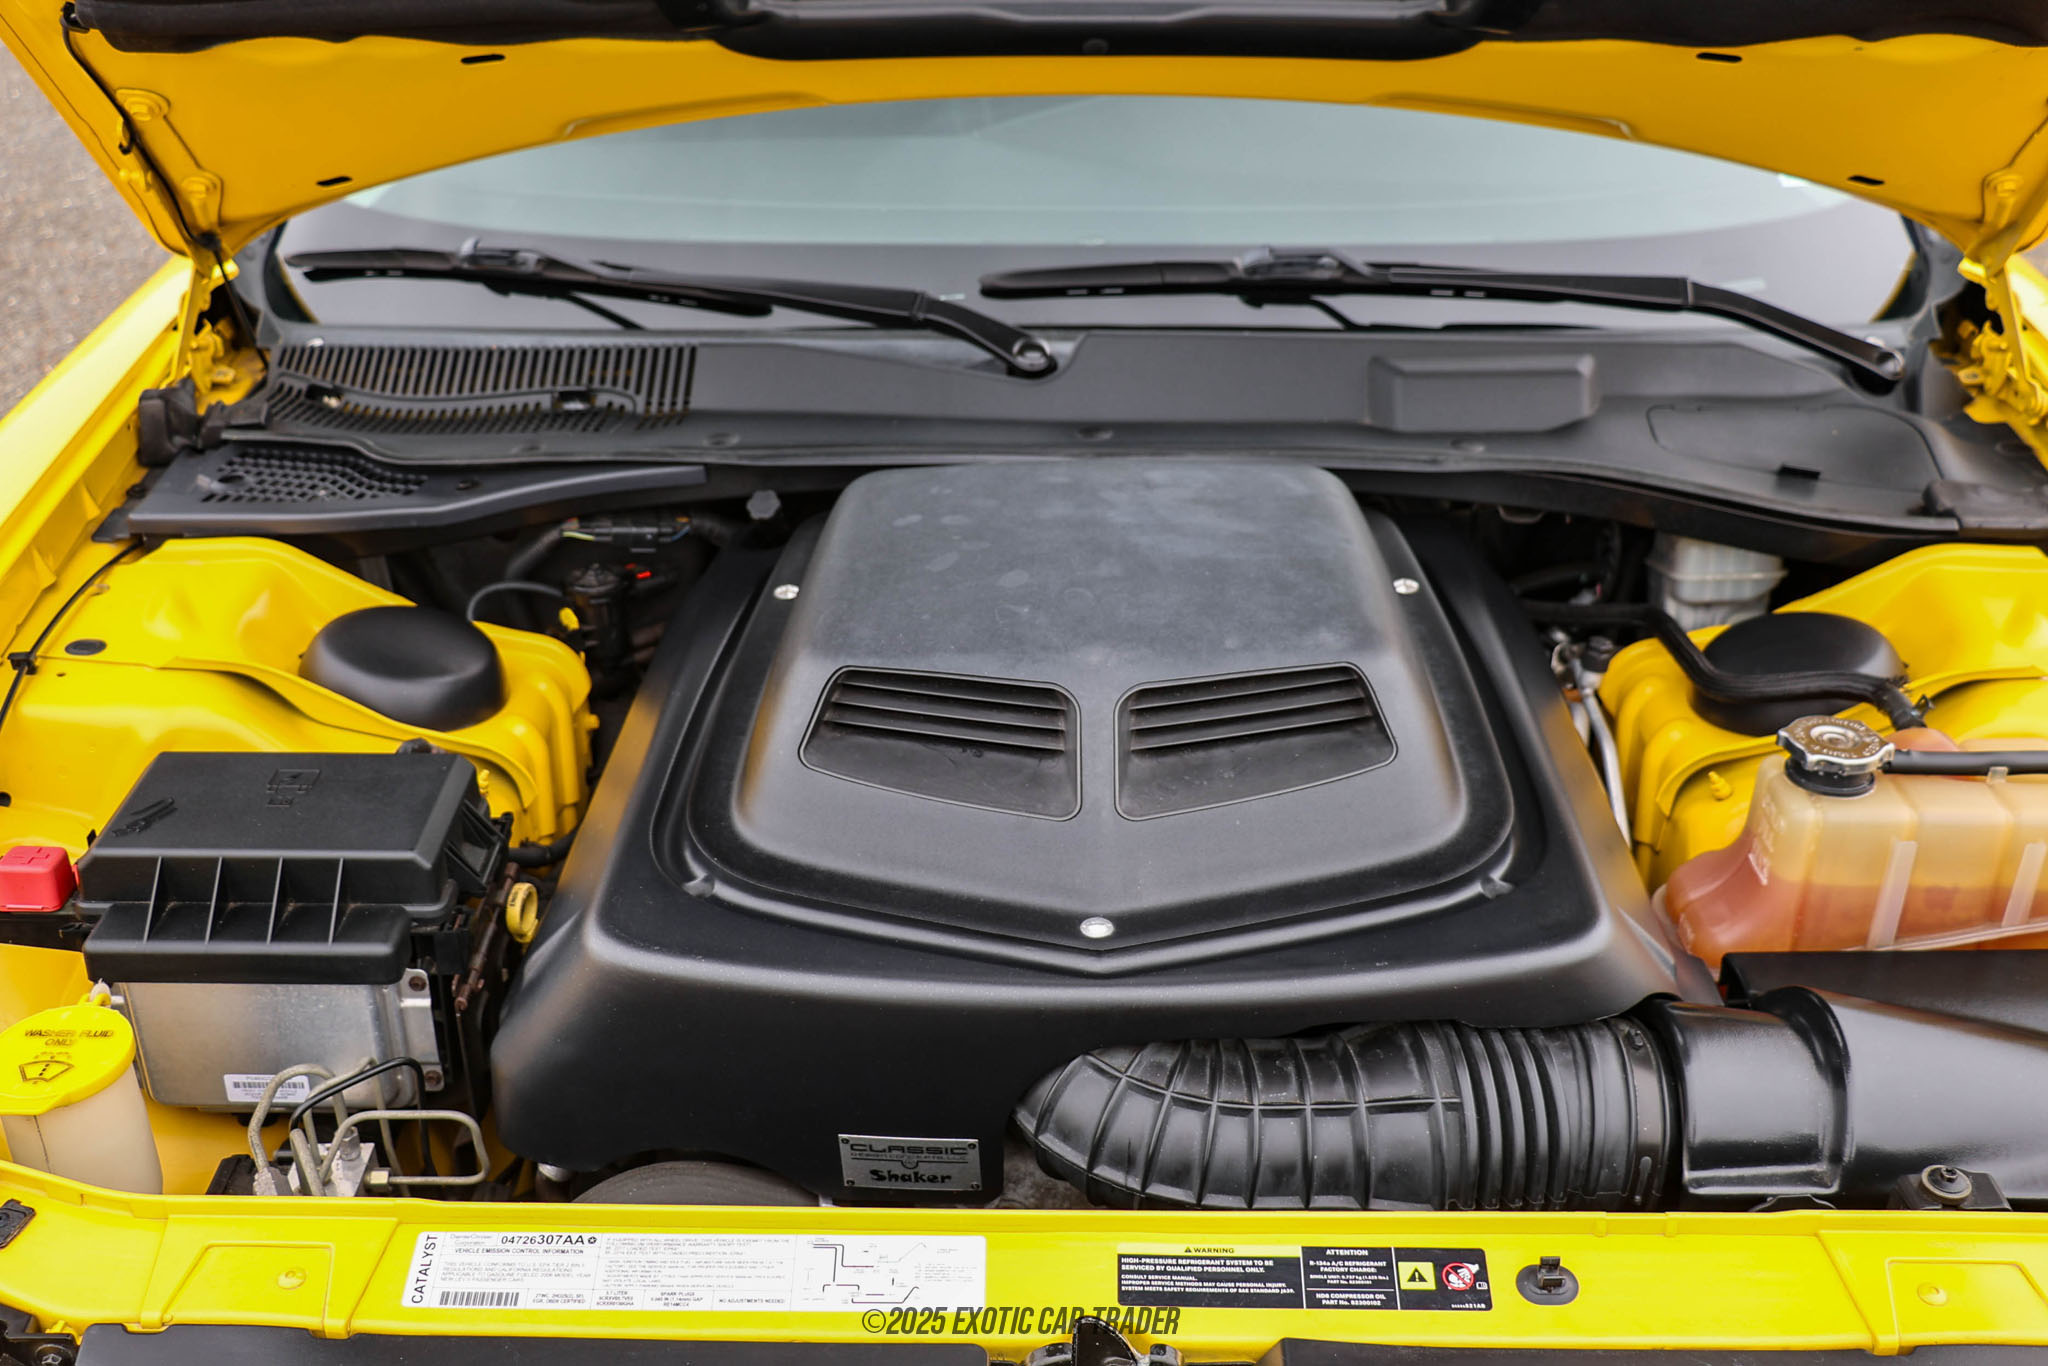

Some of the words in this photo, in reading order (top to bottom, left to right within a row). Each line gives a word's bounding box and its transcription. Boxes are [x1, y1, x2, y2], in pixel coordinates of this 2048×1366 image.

[79, 1029, 114, 1038] FLUID
[850, 1143, 968, 1155] CLASSIC
[869, 1168, 952, 1184] Shaker
[501, 1234, 585, 1246] 04726307AA
[1121, 1257, 1177, 1265] HIGH-PRESSURE
[1178, 1258, 1225, 1266] REFRIGERANT
[411, 1234, 438, 1304] CATALYST
